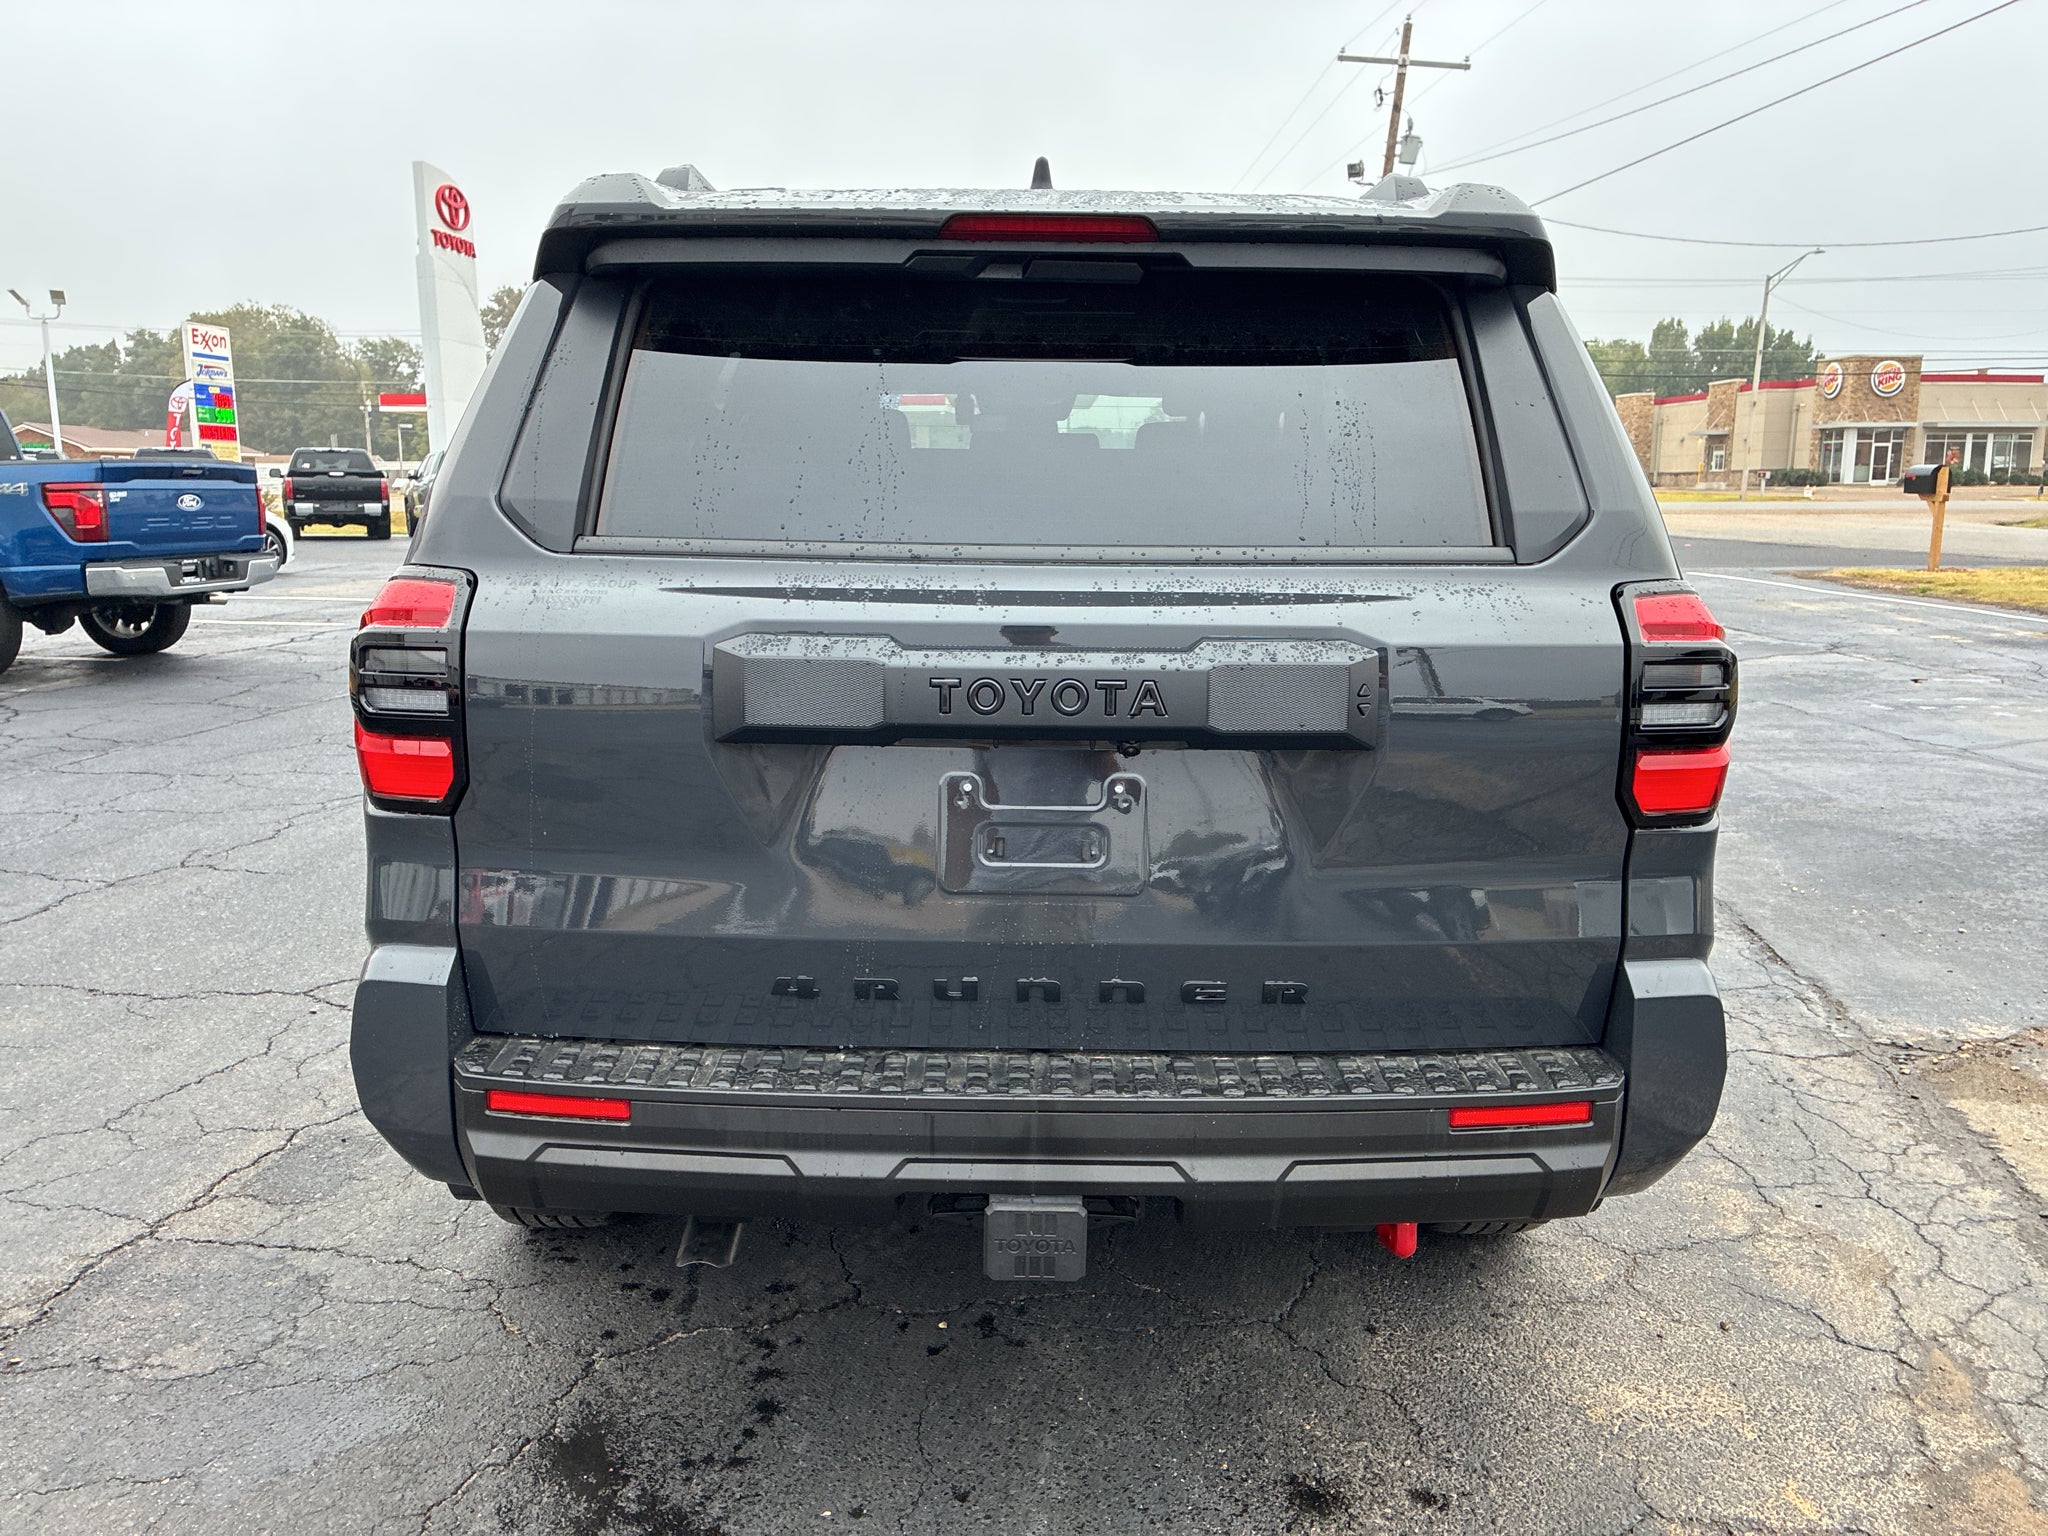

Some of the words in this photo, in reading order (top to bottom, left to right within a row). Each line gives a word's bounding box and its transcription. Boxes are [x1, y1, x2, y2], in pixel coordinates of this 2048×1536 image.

[430, 228, 477, 258] TOYOTA
[191, 328, 227, 353] Exxon
[1877, 373, 1902, 387] KING
[587, 579, 638, 589] GROUP
[929, 677, 1169, 718] TOYOTA
[993, 1238, 1077, 1255] TOYOTA
